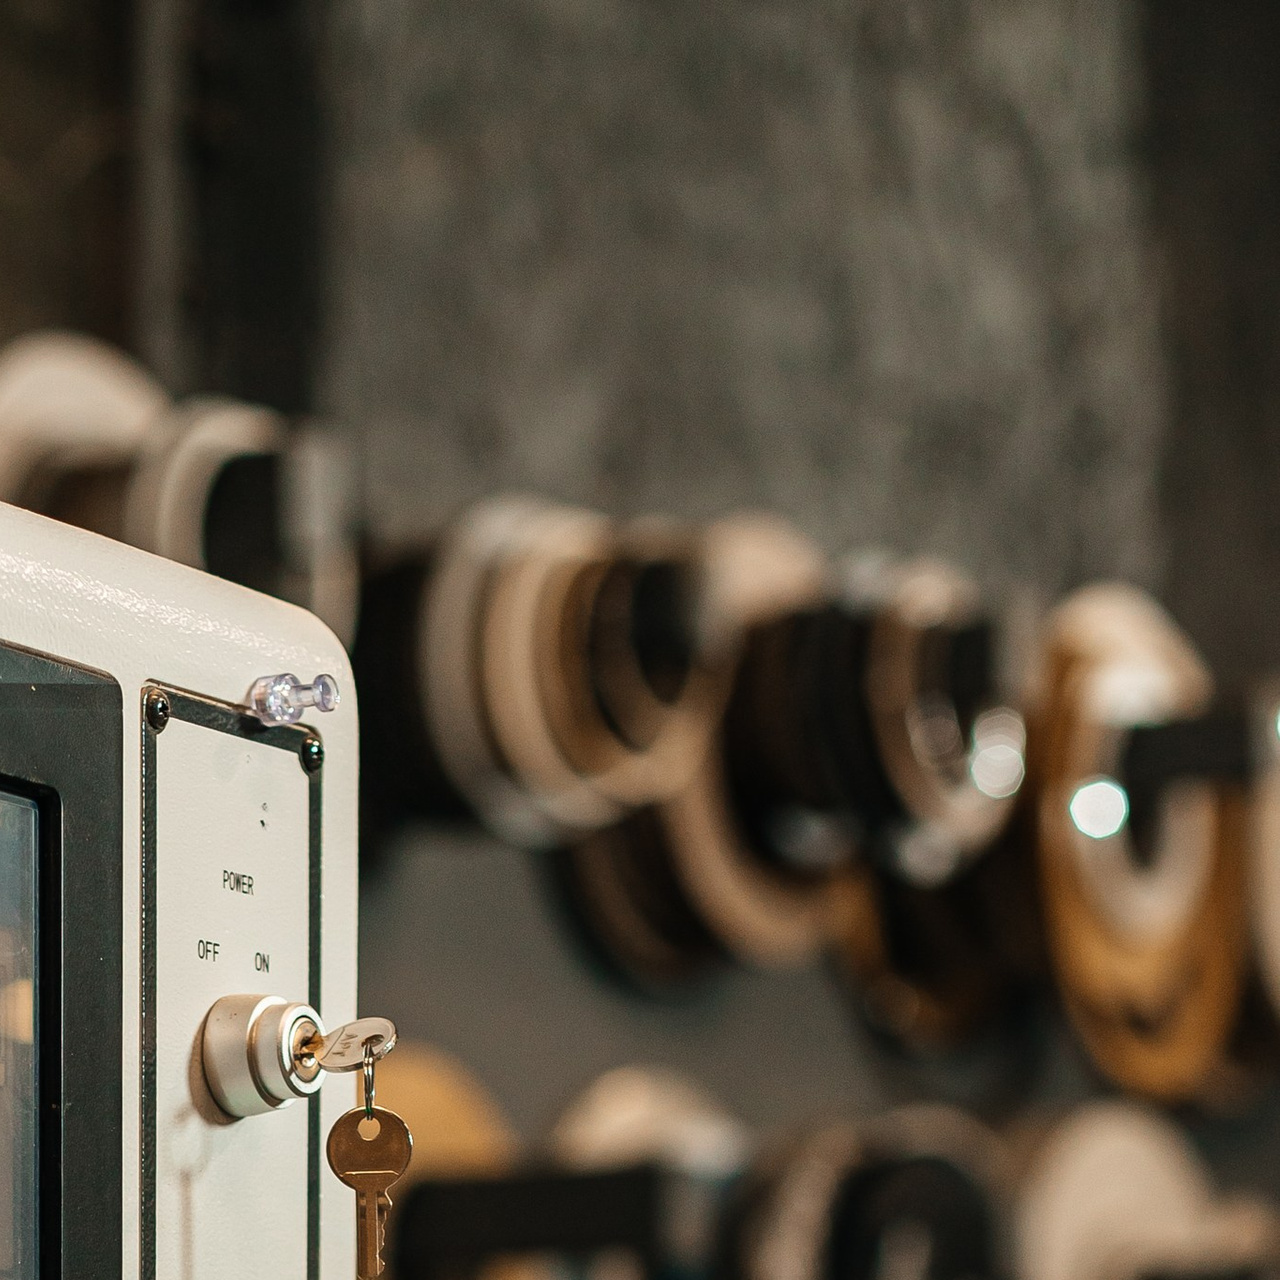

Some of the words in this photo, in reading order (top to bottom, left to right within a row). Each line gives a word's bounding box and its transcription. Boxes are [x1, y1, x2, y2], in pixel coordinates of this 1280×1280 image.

[222, 869, 254, 895] POWER
[197, 939, 220, 962] OFF
[254, 952, 270, 973] ON
